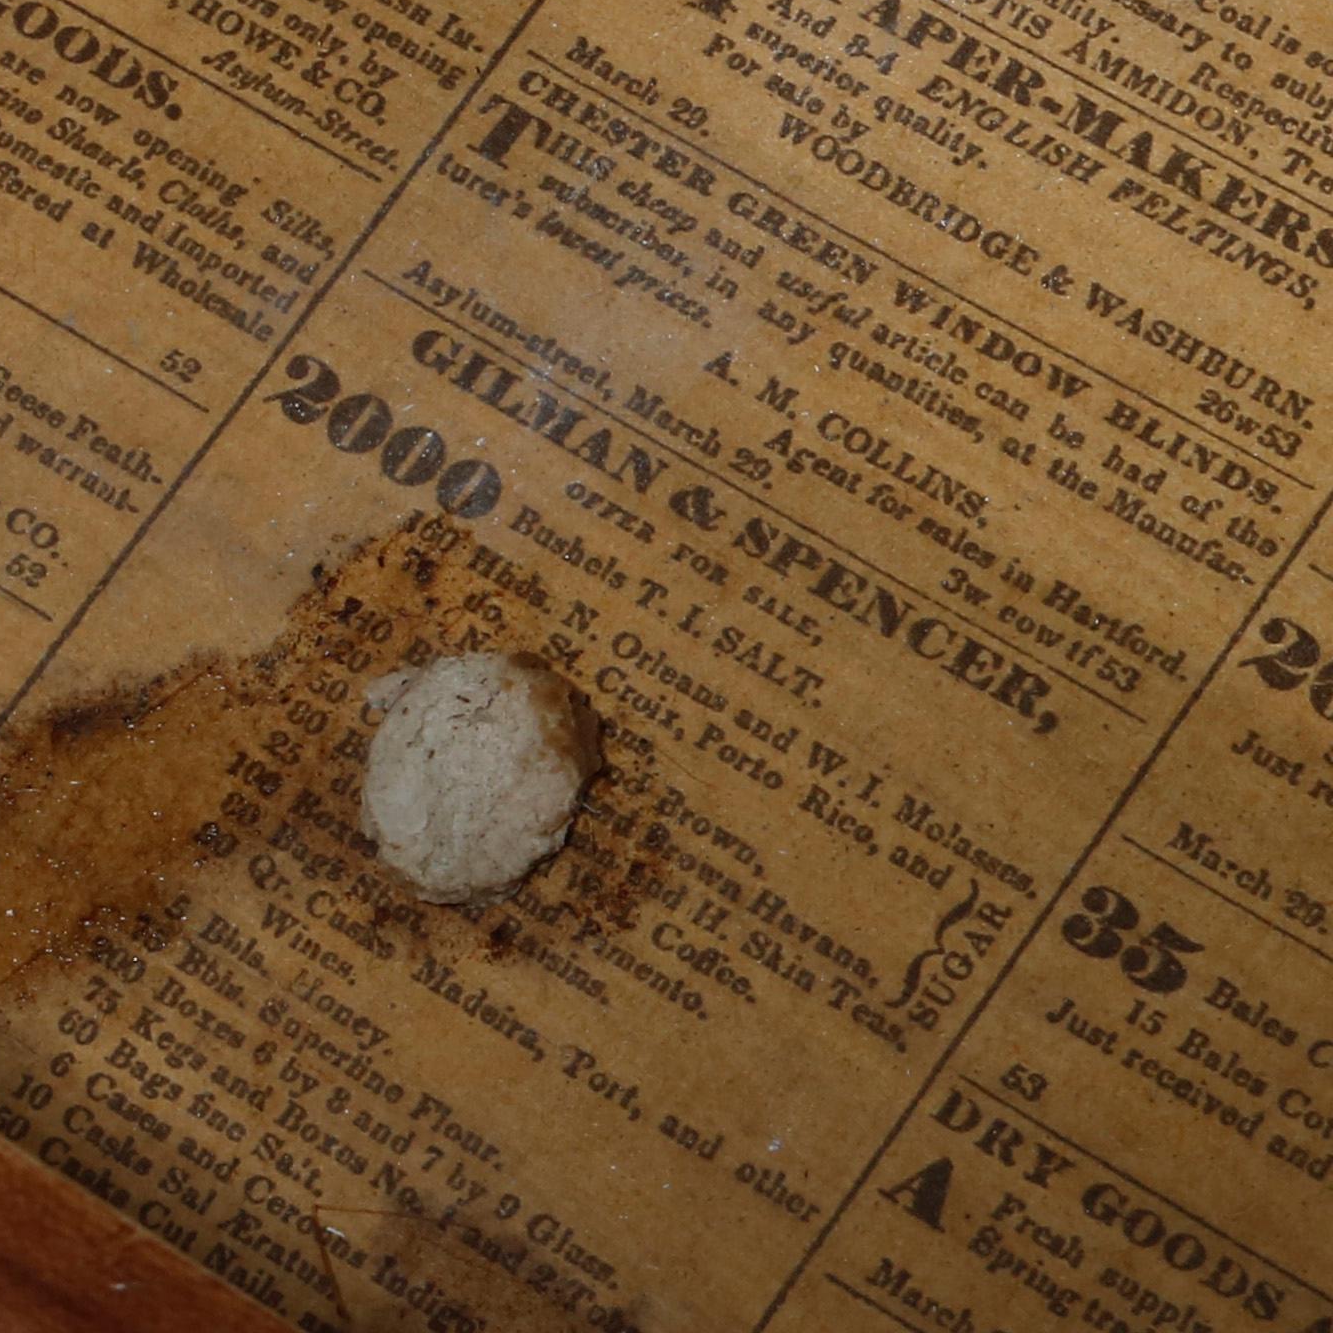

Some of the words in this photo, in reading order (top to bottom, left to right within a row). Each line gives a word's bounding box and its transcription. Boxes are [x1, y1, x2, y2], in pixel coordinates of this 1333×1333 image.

[261, 353, 503, 519] 2000
[411, 329, 670, 495] GILMAN
[731, 516, 1060, 736] SPENCER,
[906, 901, 1013, 1032] SUGAR
[1060, 884, 1205, 994] 35
[932, 1087, 1075, 1188] DRY
[1079, 1182, 1284, 1321] GOODS
